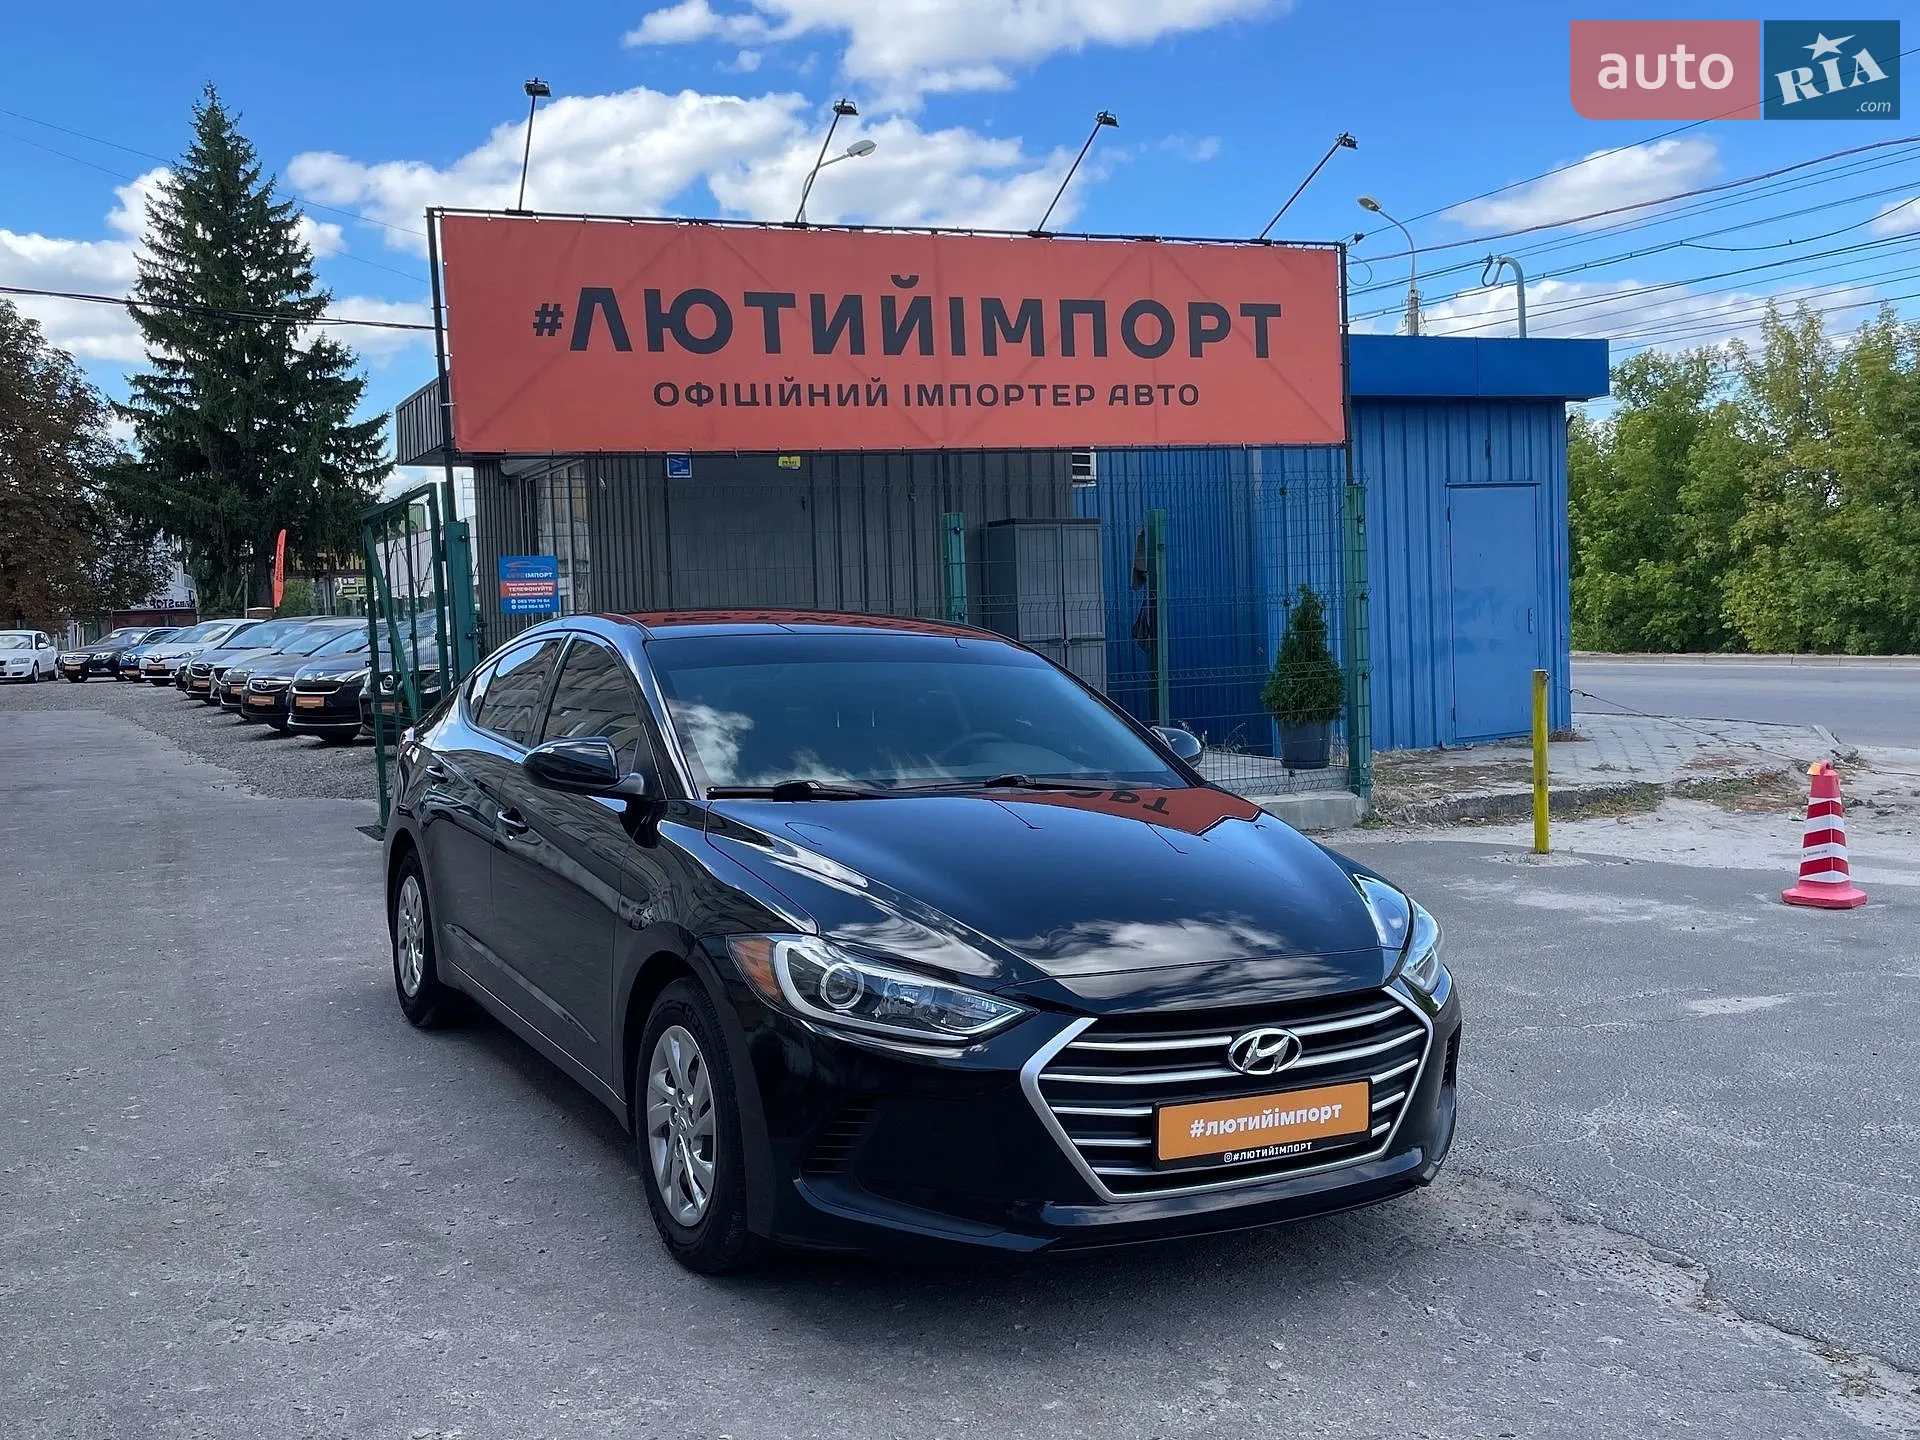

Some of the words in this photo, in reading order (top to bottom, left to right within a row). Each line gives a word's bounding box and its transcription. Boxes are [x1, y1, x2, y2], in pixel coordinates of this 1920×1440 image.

[532, 274, 1282, 360] #ЛЮТИЙІМПОРТ
[653, 376, 888, 408] ОФІЦІЙНИЙ
[903, 383, 1096, 408] ІМПОРТЕР
[1108, 383, 1200, 407] АВТО
[1190, 1103, 1343, 1138] #лютийімпорт
[1232, 1141, 1313, 1162] #ЛЮТИЙІМПОРТ
